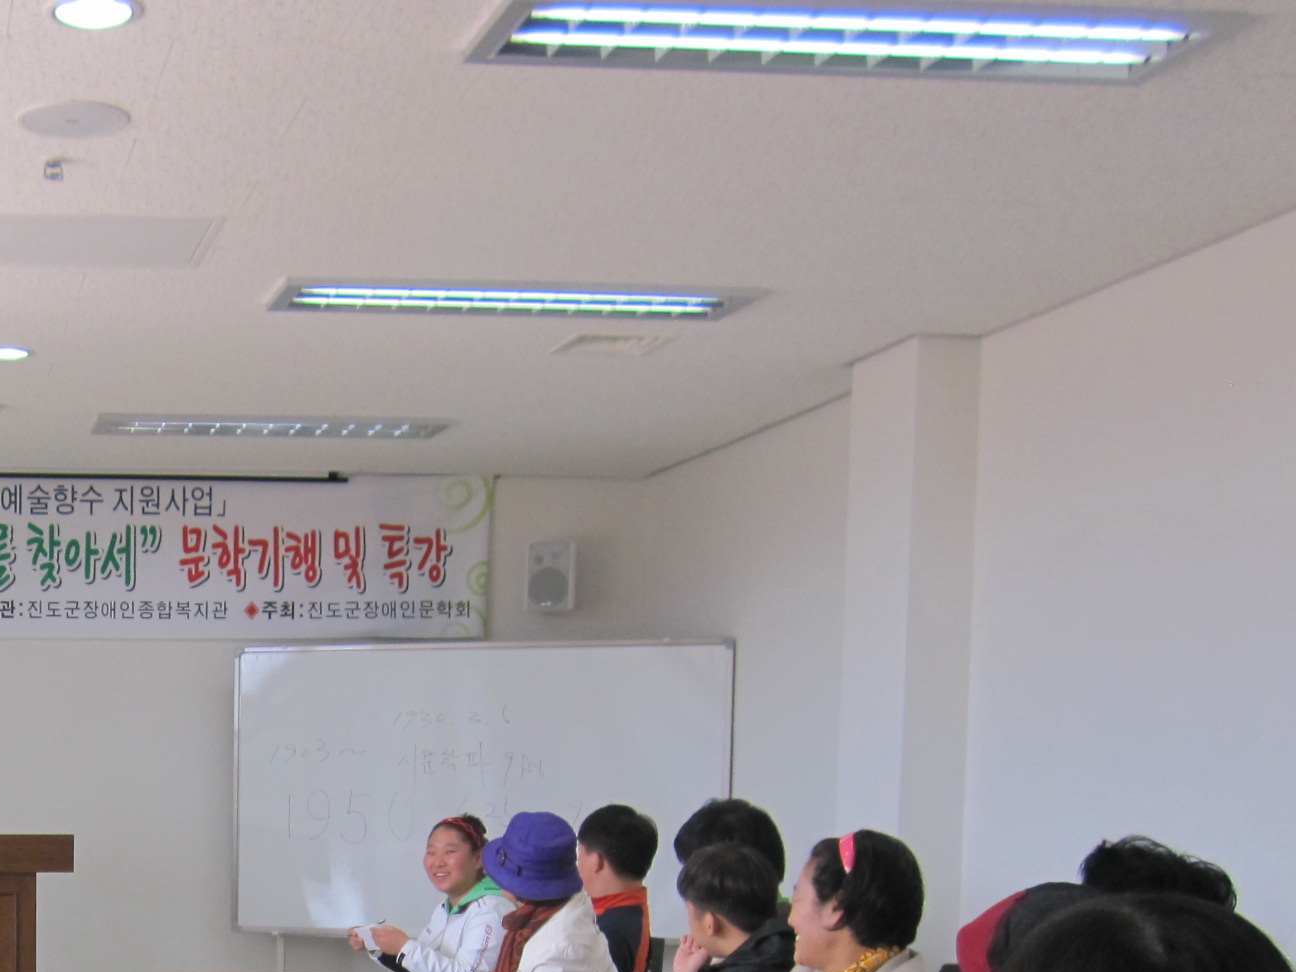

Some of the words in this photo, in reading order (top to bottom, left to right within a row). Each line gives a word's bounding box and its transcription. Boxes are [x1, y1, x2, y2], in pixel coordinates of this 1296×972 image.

[178, 524, 322, 593] 문학기행
[333, 525, 365, 594] 및
[378, 523, 453, 593] 특강
